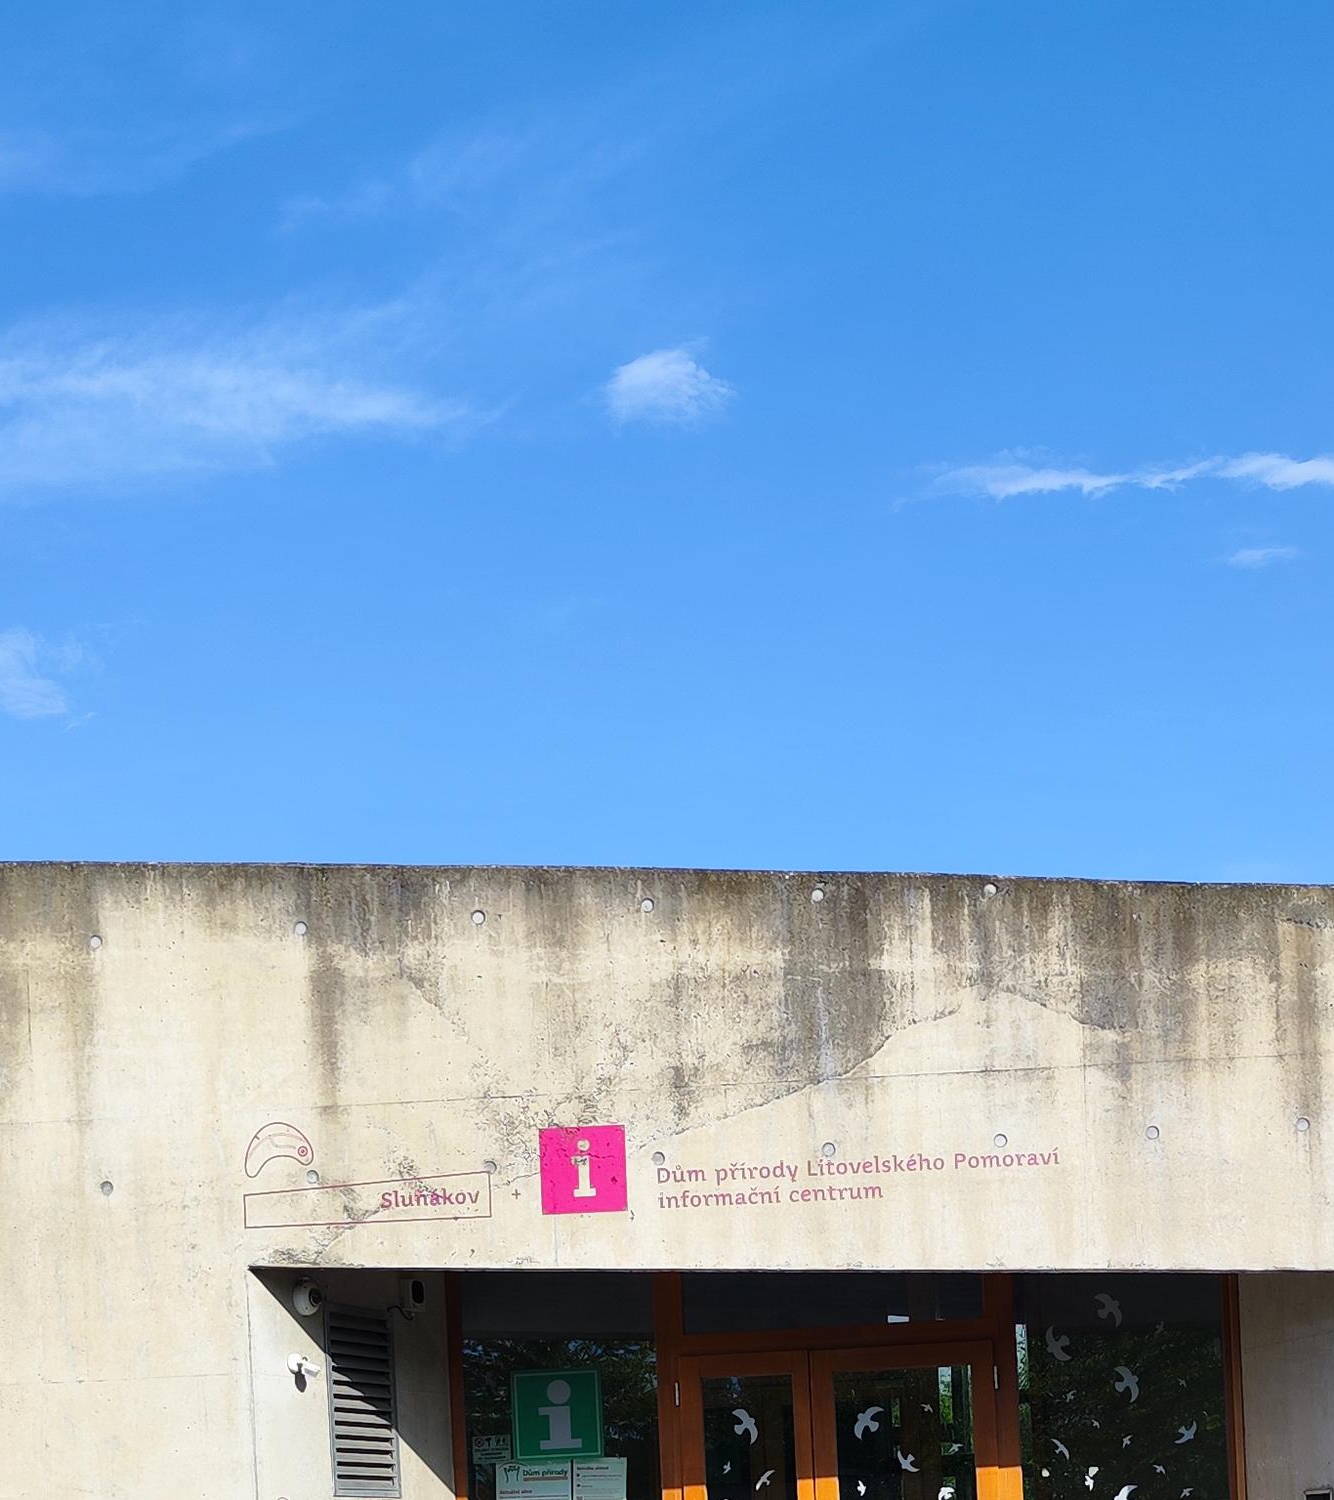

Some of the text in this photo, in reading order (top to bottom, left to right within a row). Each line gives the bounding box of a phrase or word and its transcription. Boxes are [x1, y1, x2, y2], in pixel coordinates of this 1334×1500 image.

[656, 1146, 1060, 1187] Dům přírody Litovelského Pomoraví
[380, 1187, 480, 1210] Sluňákov
[657, 1184, 884, 1209] informační centrum
[522, 1468, 541, 1478] Dům
